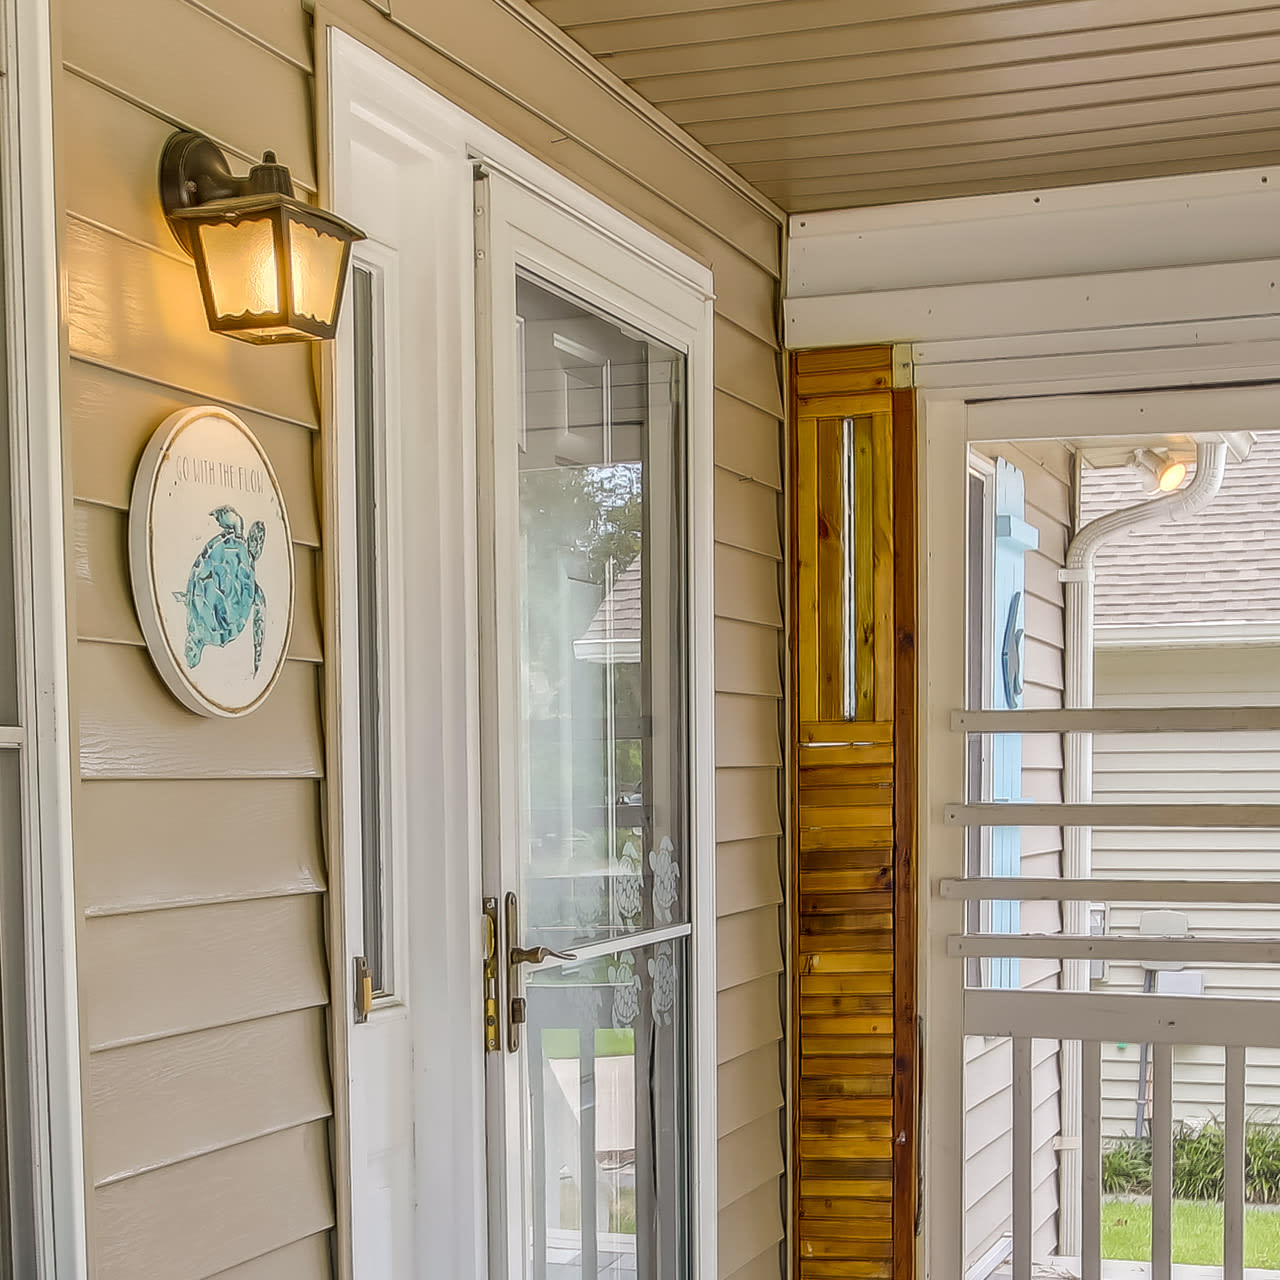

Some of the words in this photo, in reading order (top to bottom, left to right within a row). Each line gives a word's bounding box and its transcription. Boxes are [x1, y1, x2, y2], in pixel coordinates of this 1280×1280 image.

[176, 456, 189, 481] GO
[193, 458, 215, 485] WITH
[219, 462, 233, 489] THE
[239, 466, 264, 494] FLOW
